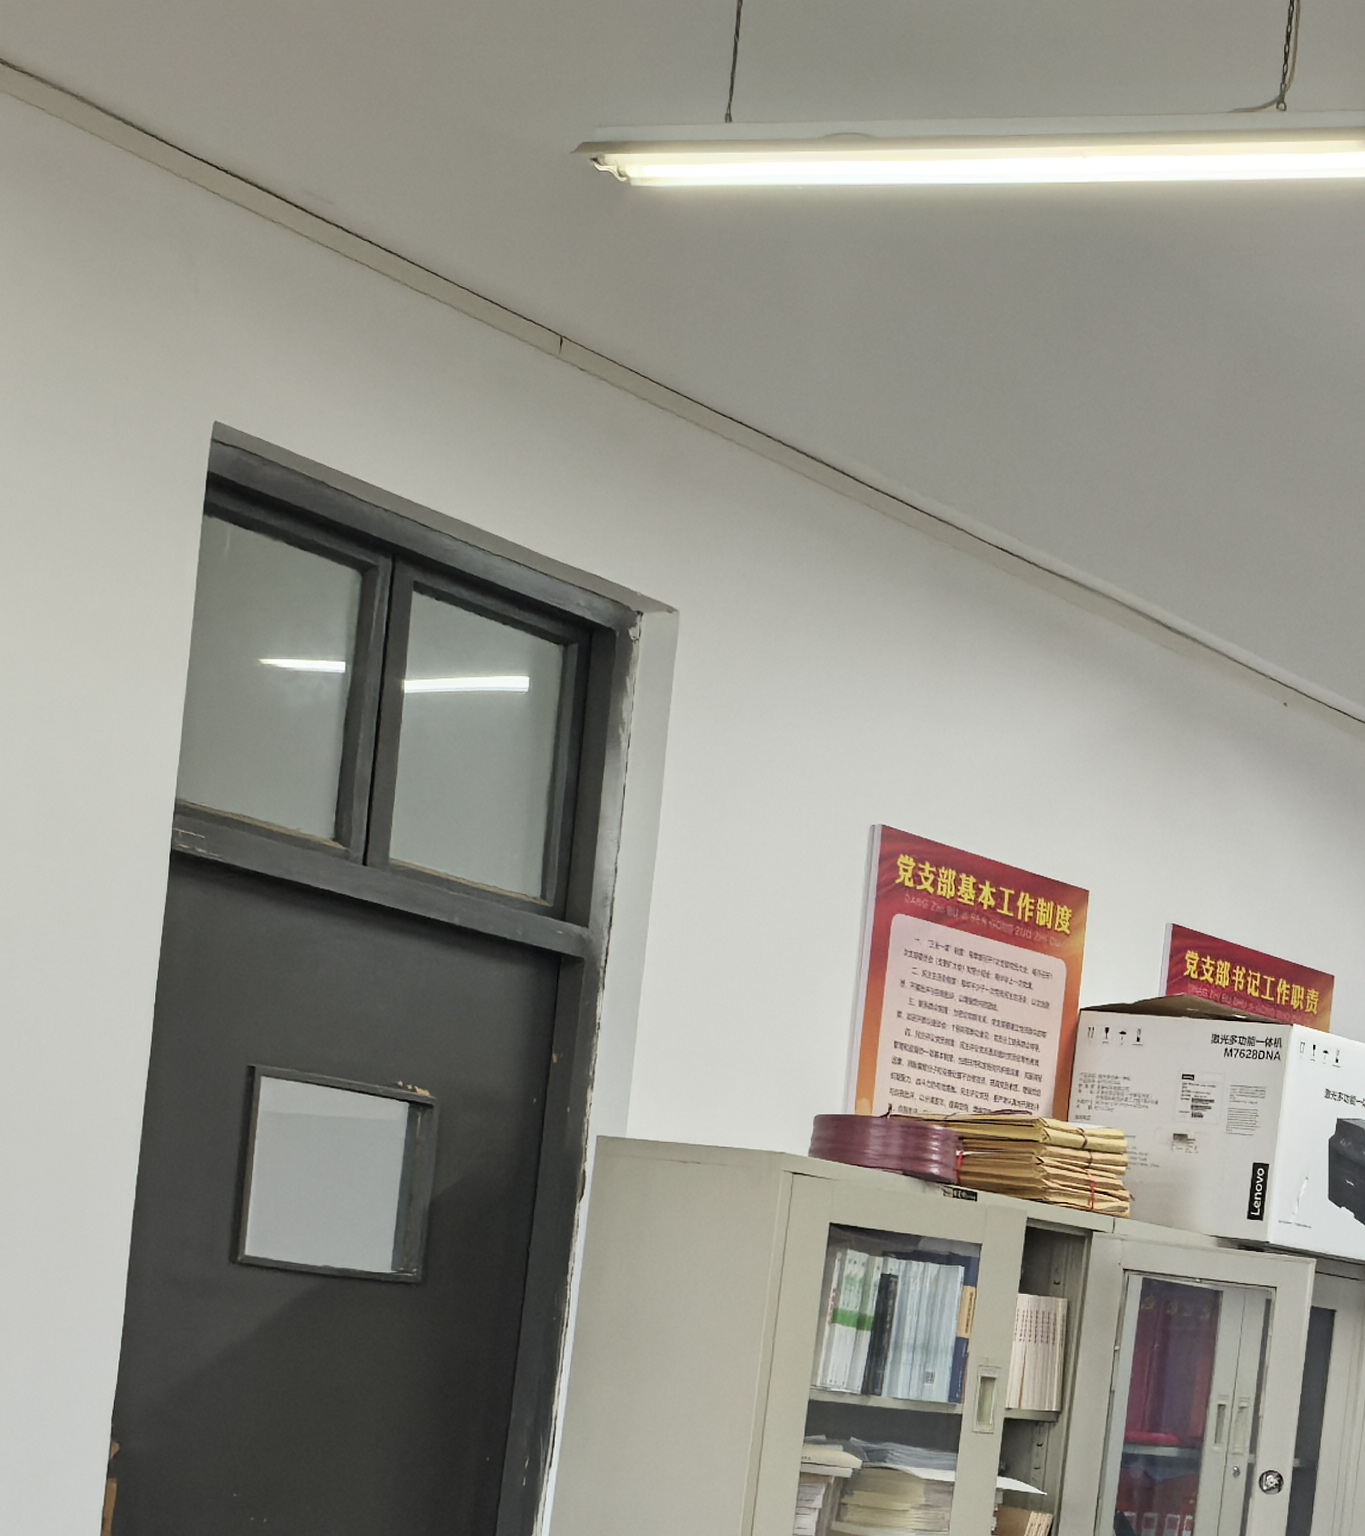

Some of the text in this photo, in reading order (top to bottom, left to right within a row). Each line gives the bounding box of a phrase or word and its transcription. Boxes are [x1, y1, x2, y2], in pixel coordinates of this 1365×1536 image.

[895, 854, 1072, 935] 党支部基本工作制度
[1184, 949, 1320, 1015] 党支部书记工作职责
[1211, 1033, 1283, 1049] 激光多功能一体机
[1224, 1048, 1282, 1062] M7628DNA
[1249, 1166, 1266, 1218] Lenovo
